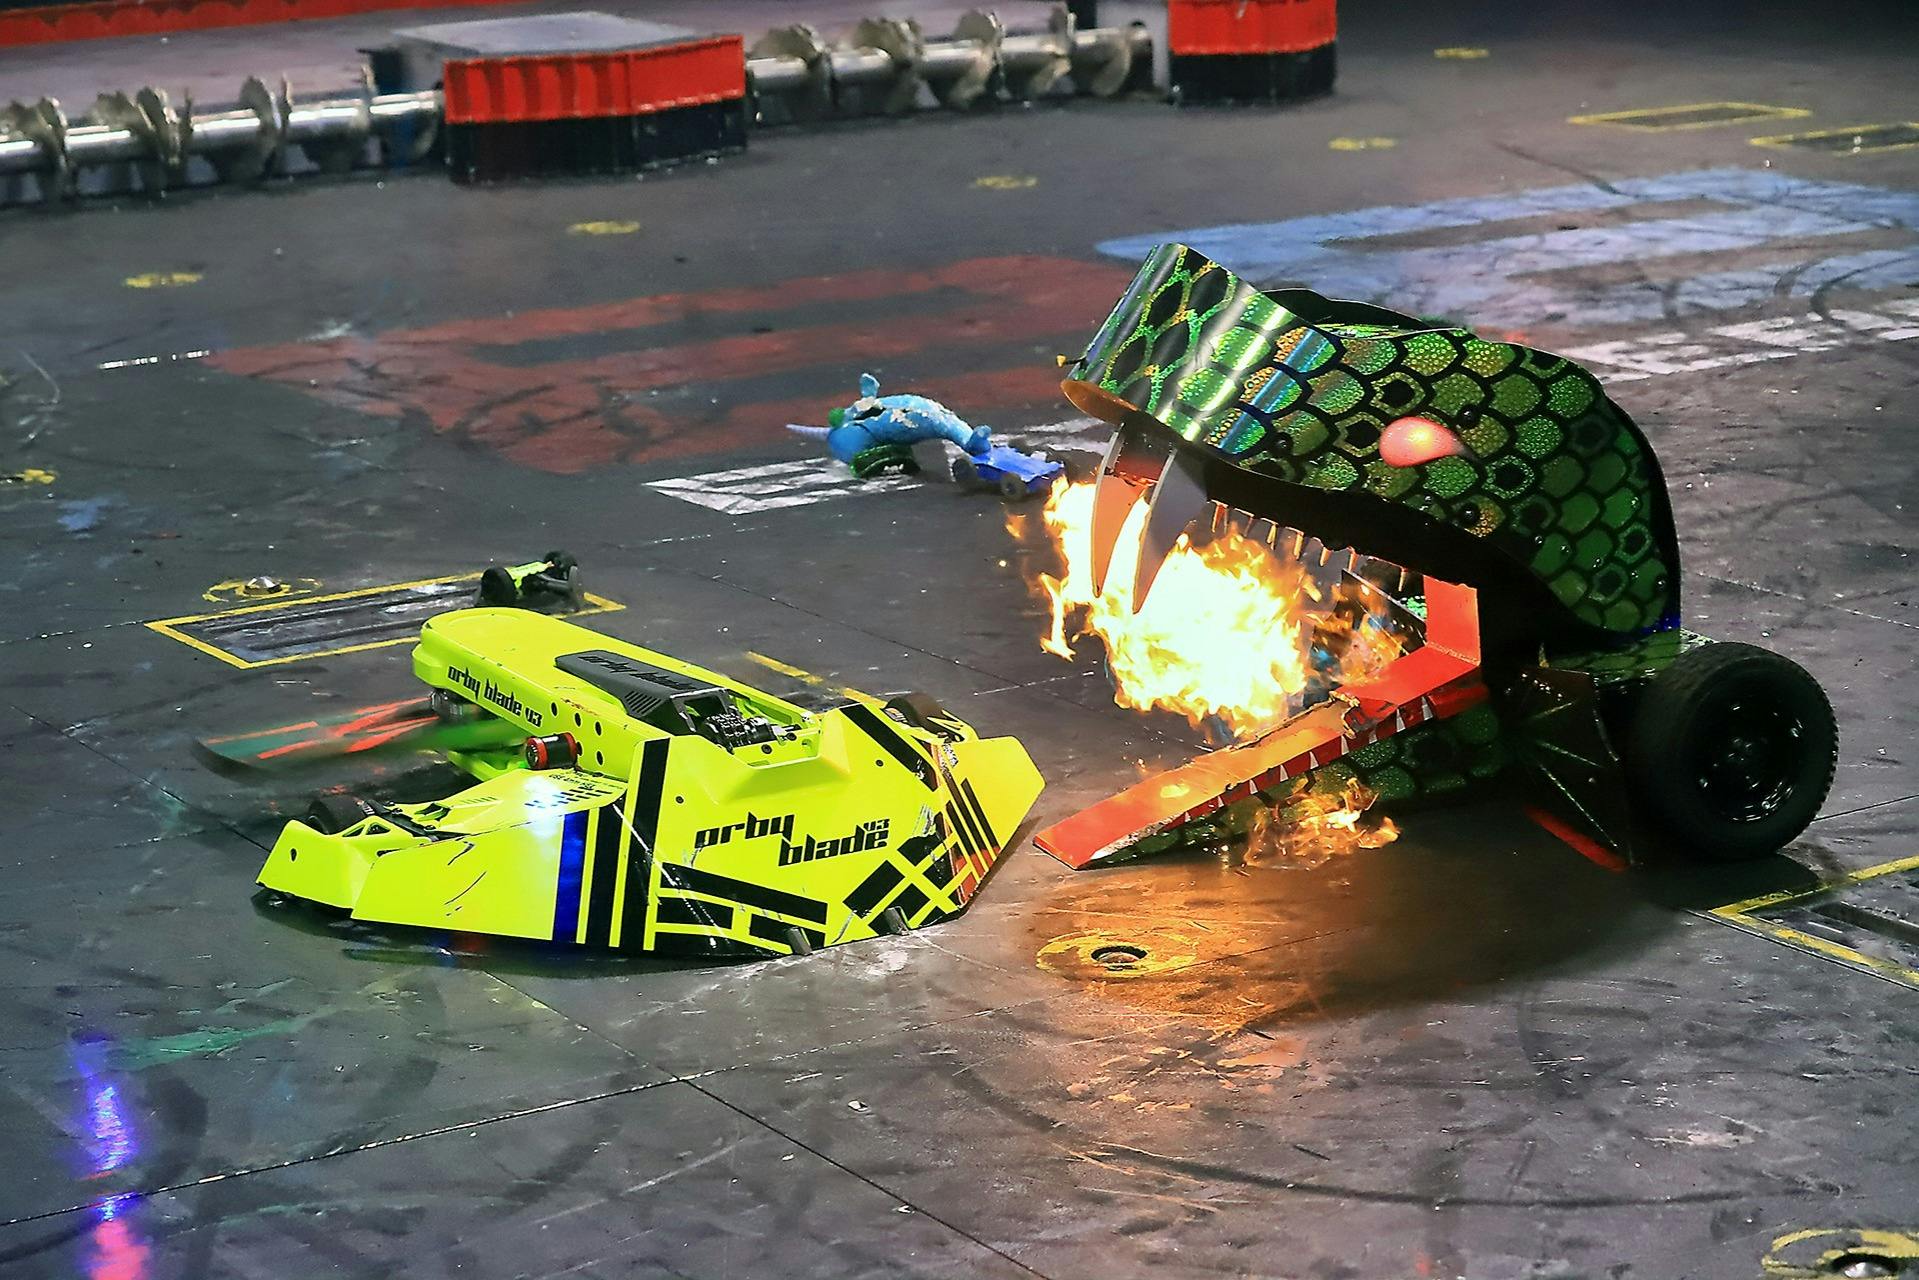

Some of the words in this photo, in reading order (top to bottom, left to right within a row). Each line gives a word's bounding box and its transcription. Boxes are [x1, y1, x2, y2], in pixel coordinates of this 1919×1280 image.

[447, 665, 481, 701] orby
[484, 678, 523, 717] blade
[694, 811, 795, 848] orby
[778, 824, 889, 867] blade
